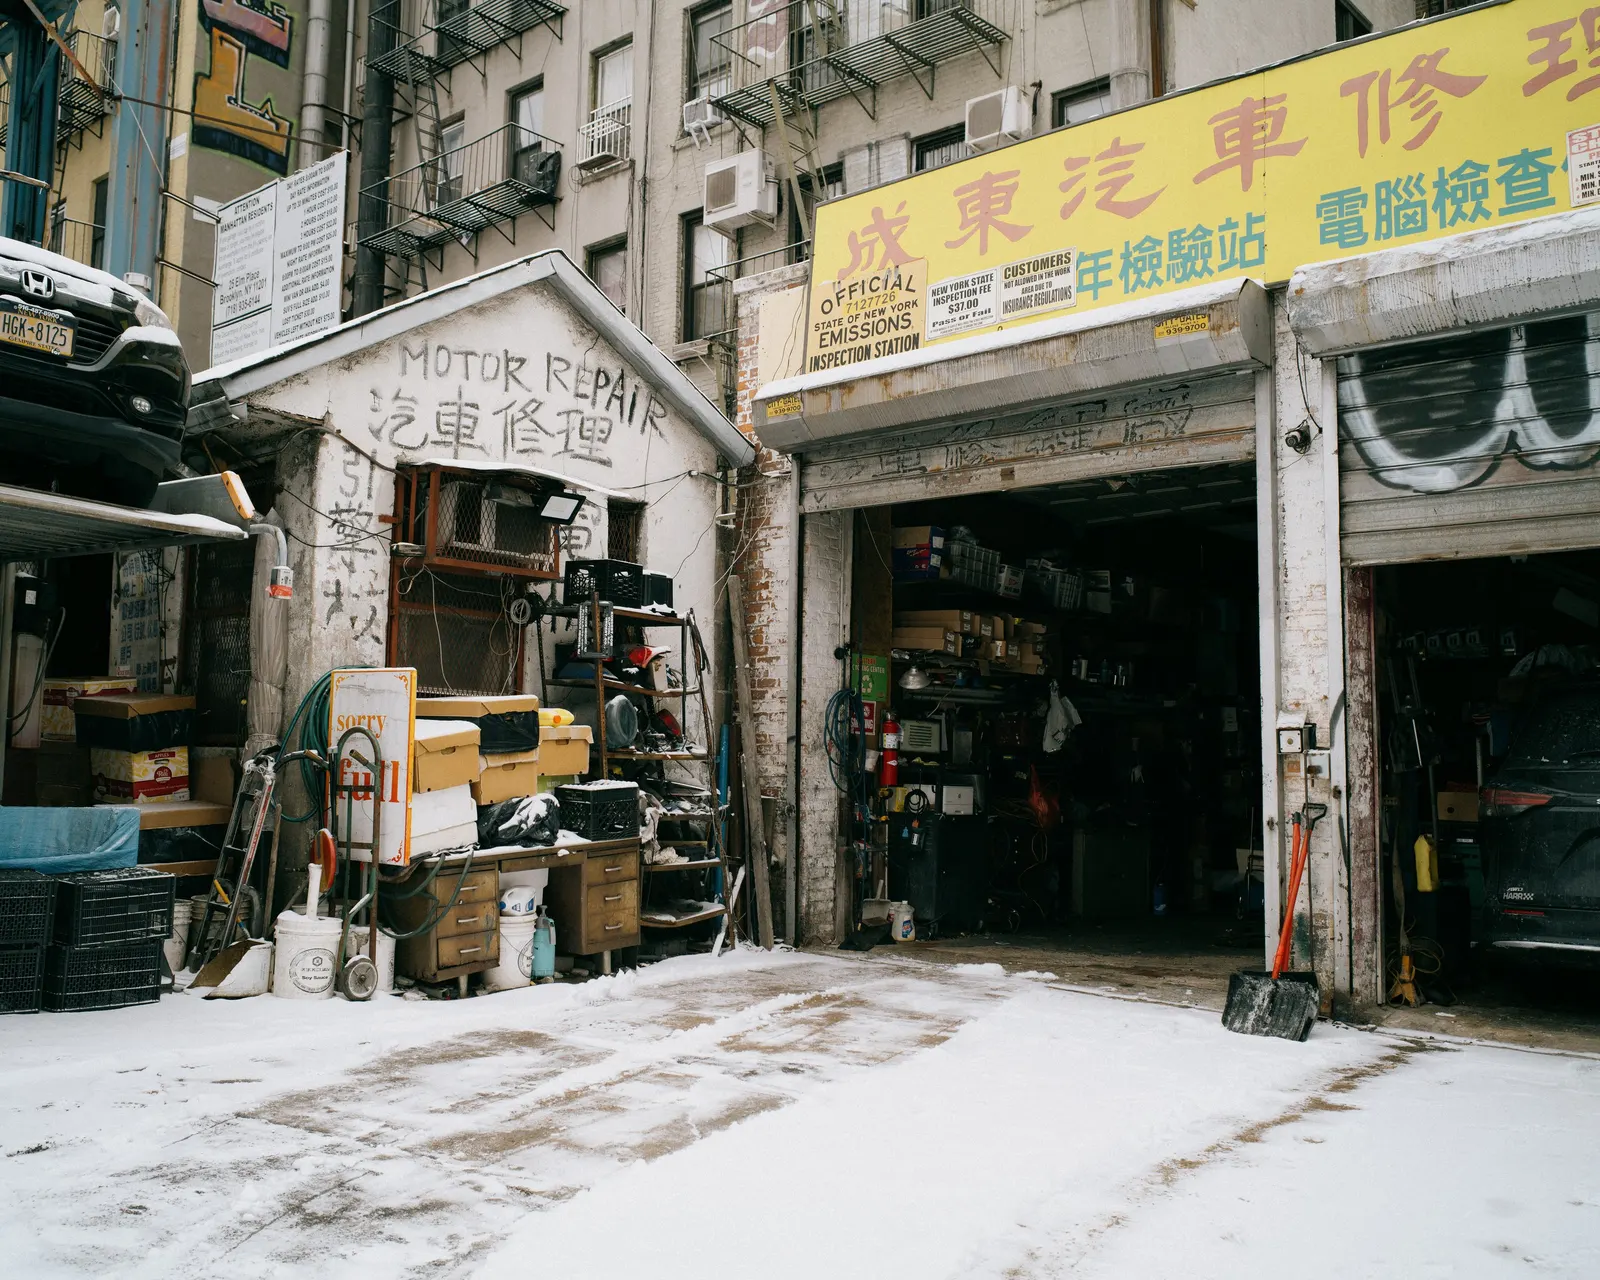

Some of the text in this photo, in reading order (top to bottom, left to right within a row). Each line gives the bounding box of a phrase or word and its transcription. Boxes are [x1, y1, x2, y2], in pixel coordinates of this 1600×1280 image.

[220, 214, 248, 234] MANHATTAN
[248, 202, 273, 221] RESIDENTS
[234, 196, 260, 215] ATTENTION
[1004, 251, 1071, 280] CUSTOMERS
[1004, 281, 1014, 289] NOT
[1014, 275, 1037, 287] ALLOWED
[1045, 271, 1054, 279] THE
[1054, 266, 1070, 277] WORK
[820, 274, 916, 315] OFFICIAL
[931, 272, 994, 297] NEW YORK STATE
[933, 284, 992, 306] INSPECTION FEE
[1021, 281, 1052, 295] AREA DUE TO
[846, 290, 896, 314] 7127726
[948, 298, 979, 314] $37.00
[1002, 285, 1072, 314] INSURANCE REGULATIONS
[814, 299, 919, 331] STATE OF NEW YORK
[932, 317, 956, 328] Pass
[959, 312, 970, 321] or
[972, 308, 992, 318] Fail
[2, 314, 68, 346] HGK 8125
[819, 312, 912, 348] EMISSIONS
[809, 333, 920, 372] INSPECTION STATION
[400, 342, 668, 439] MOTOR REPAIR
[369, 385, 614, 468] 汽車修理
[336, 714, 387, 738] sorry
[338, 758, 400, 803] full
